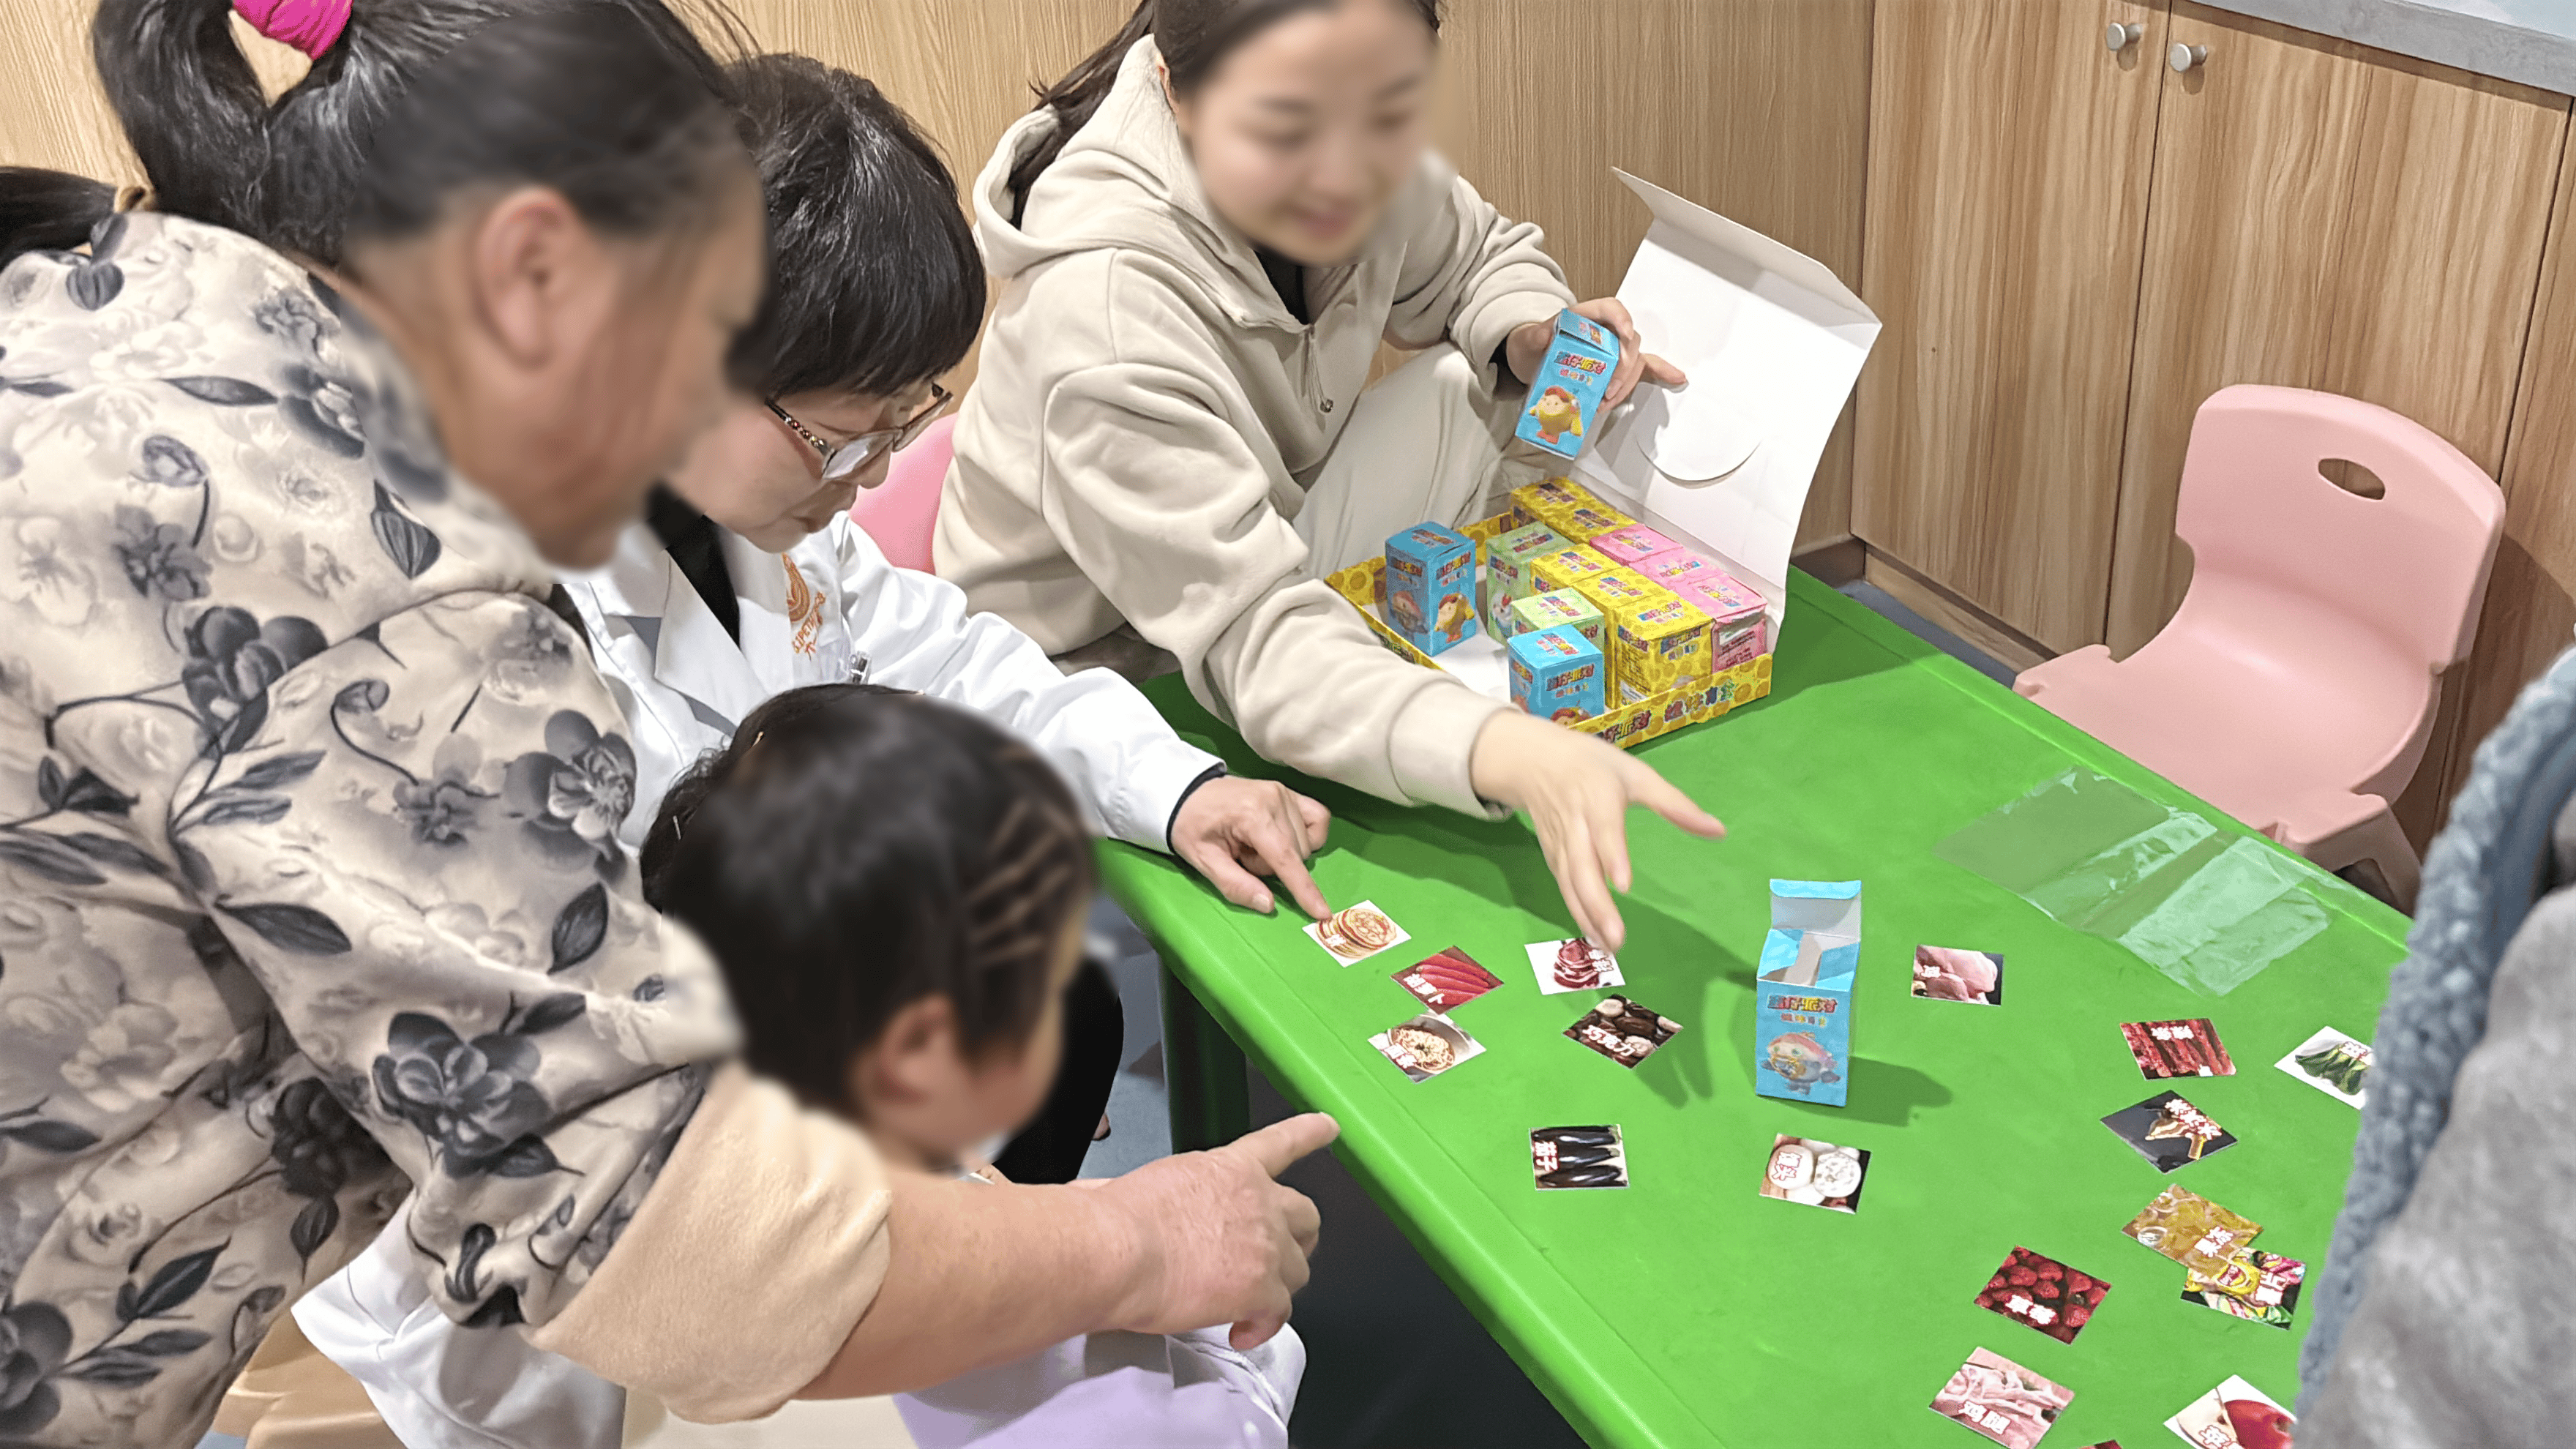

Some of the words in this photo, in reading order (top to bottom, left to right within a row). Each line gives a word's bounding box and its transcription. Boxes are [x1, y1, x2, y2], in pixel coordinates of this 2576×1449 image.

[1403, 973, 1445, 1004] 胡萝卜
[1382, 1043, 1418, 1068] 面条
[1582, 1025, 1636, 1056] 巧克力
[2164, 1098, 2223, 1140] 冰淇淋
[1534, 1141, 1558, 1171] 茄子
[1771, 1151, 1802, 1181] 馒头
[2194, 1226, 2234, 1258] 果冻
[2254, 1271, 2288, 1306] 薯片
[2004, 1294, 2056, 1325] 草莓
[1958, 1400, 2012, 1435] 鸡腿
